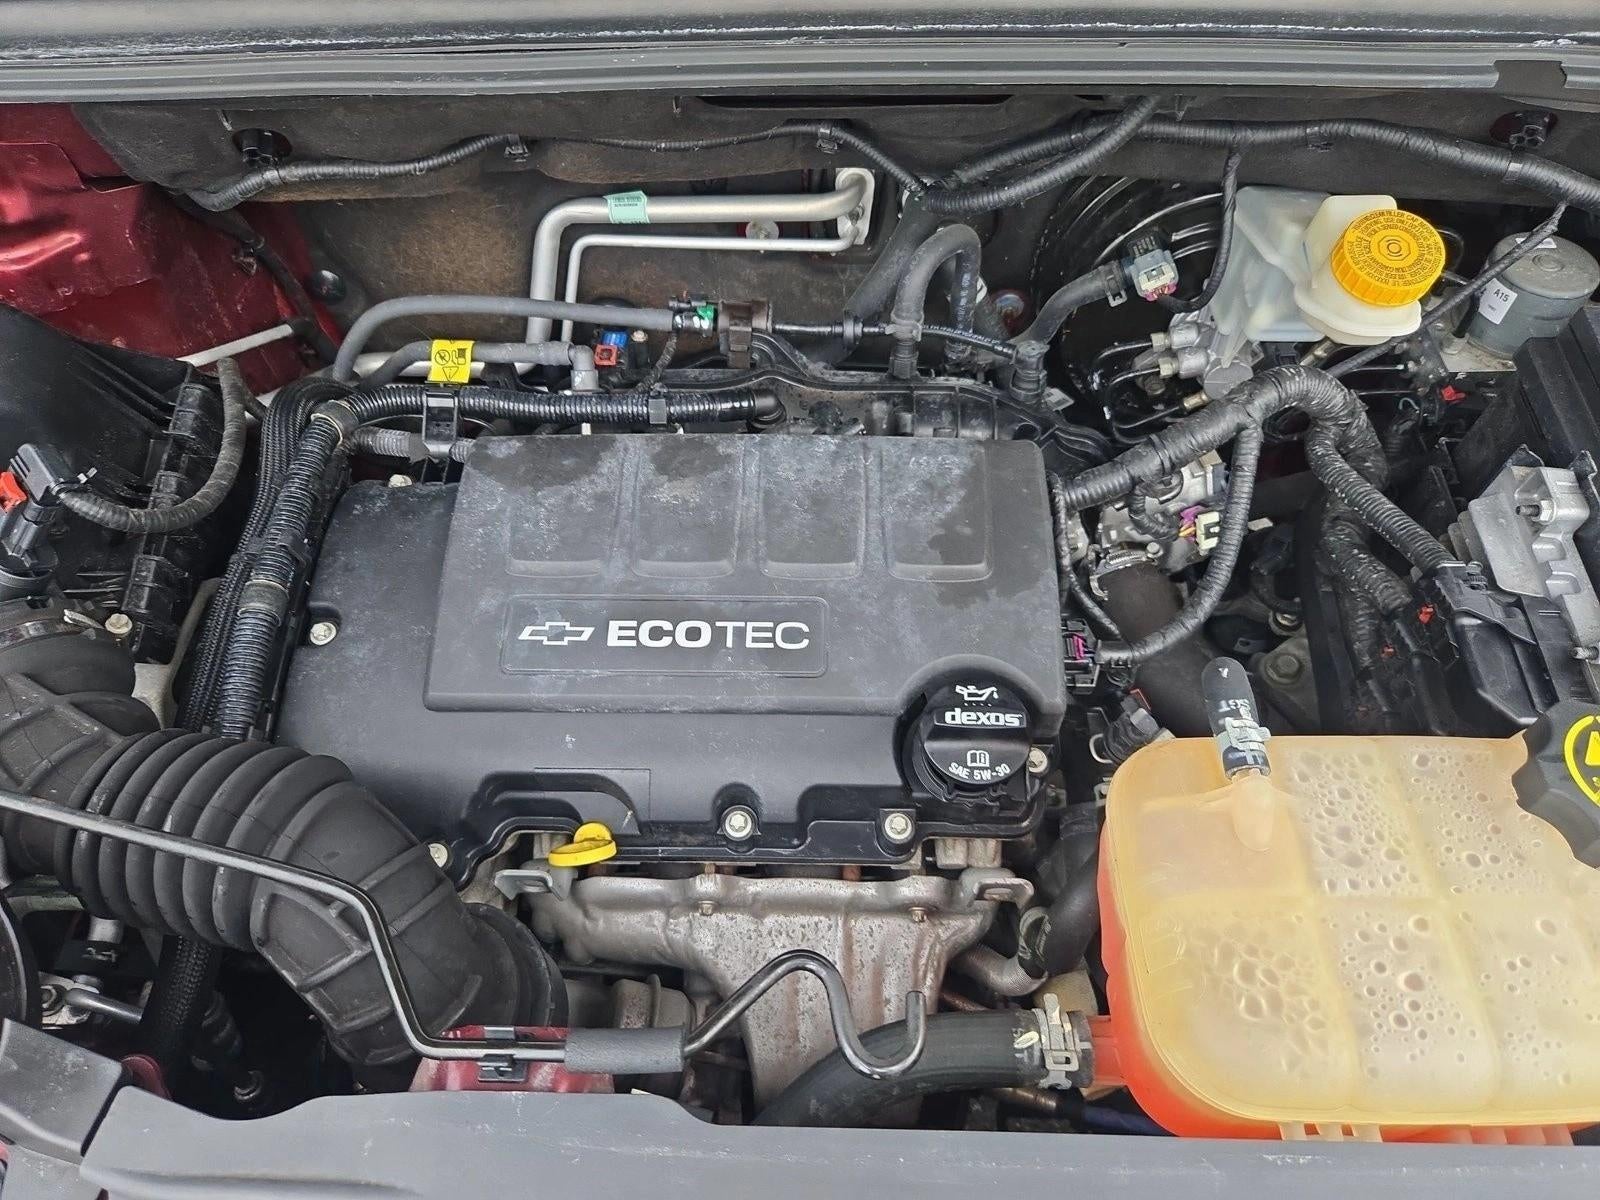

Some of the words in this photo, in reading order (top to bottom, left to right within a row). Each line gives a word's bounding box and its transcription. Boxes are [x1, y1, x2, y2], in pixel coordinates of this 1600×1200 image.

[1493, 288, 1510, 303] A15
[606, 619, 810, 650] ECOTEC
[944, 707, 1021, 727] dexos
[948, 762, 971, 779] SAE
[973, 763, 1011, 780] 5W-30
